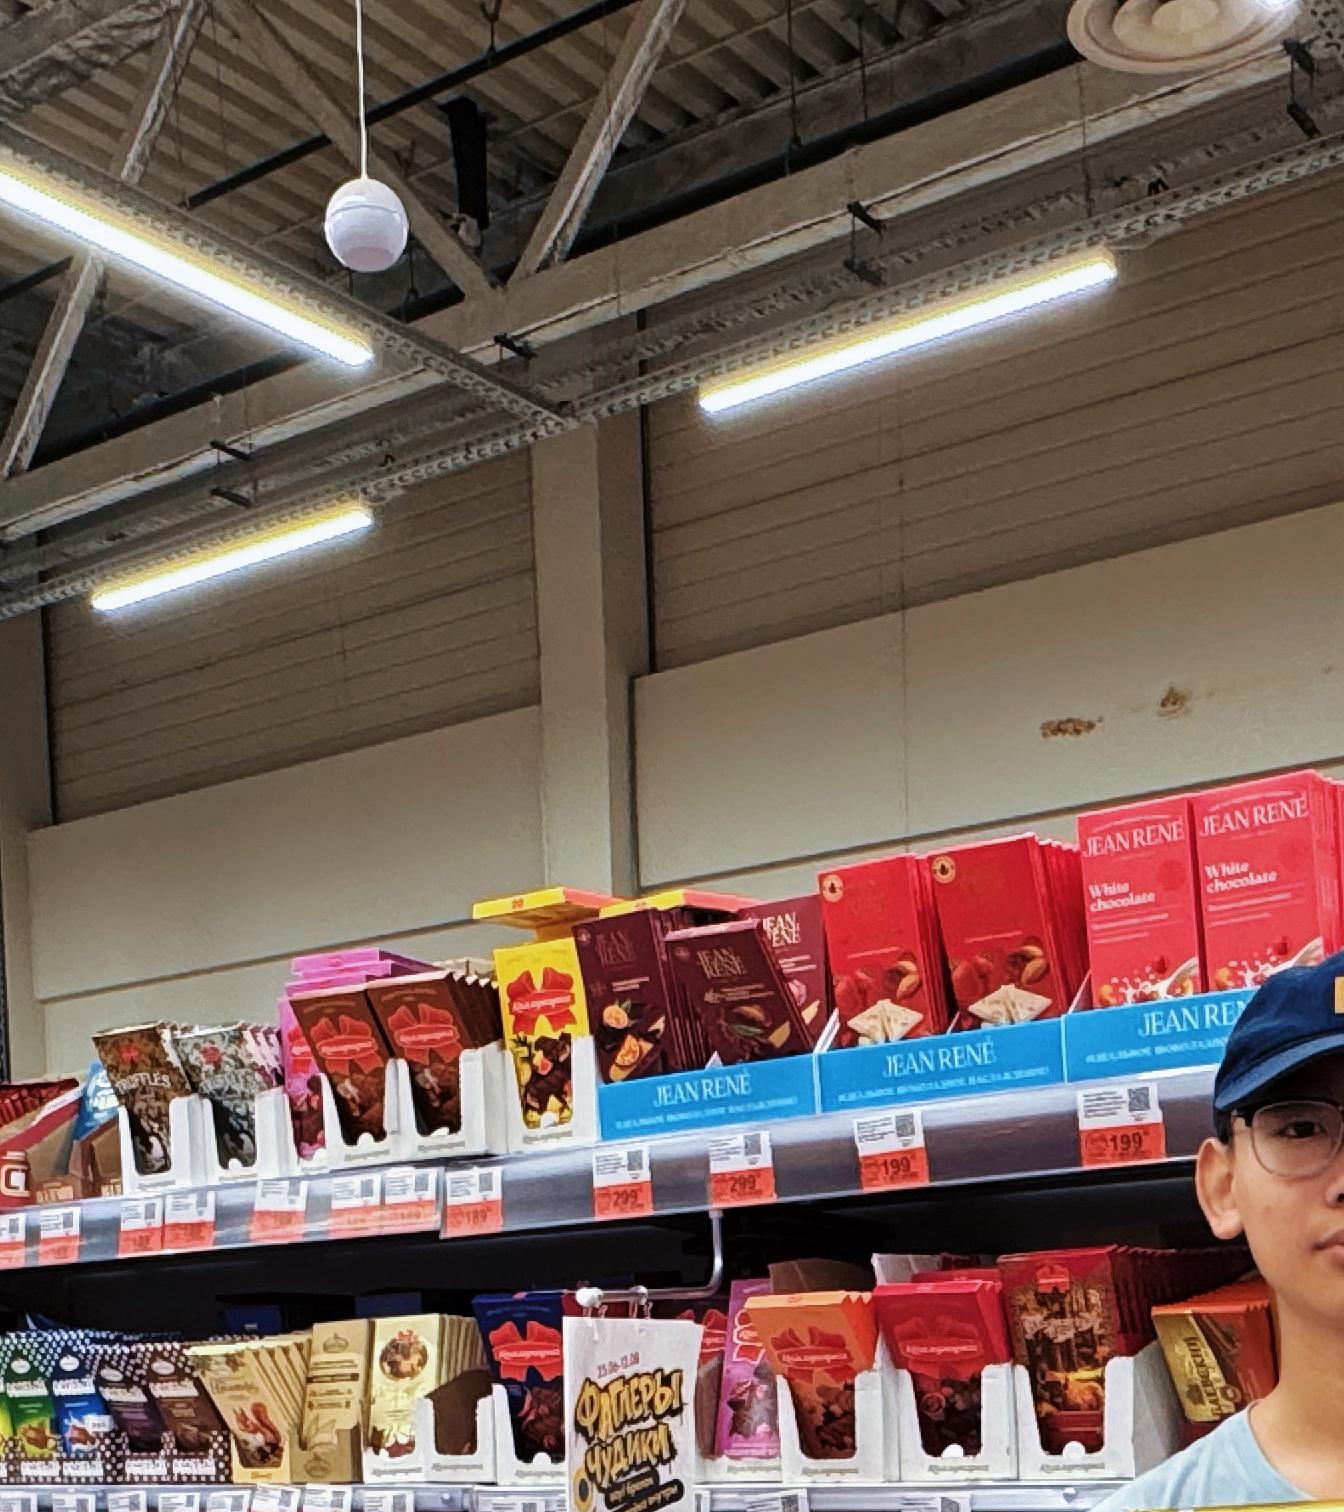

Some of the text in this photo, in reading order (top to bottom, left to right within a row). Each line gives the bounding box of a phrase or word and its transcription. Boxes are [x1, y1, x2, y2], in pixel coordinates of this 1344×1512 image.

[1200, 810, 1250, 838] JEAN
[1082, 829, 1133, 857] JEAN
[1205, 862, 1250, 879] White
[1207, 869, 1279, 893] chocolate
[1088, 880, 1131, 897] White
[1090, 892, 1157, 913] chocolate
[1139, 1007, 1199, 1037] JEAN
[883, 1052, 934, 1078] JEAN
[654, 1077, 698, 1106] JEAN
